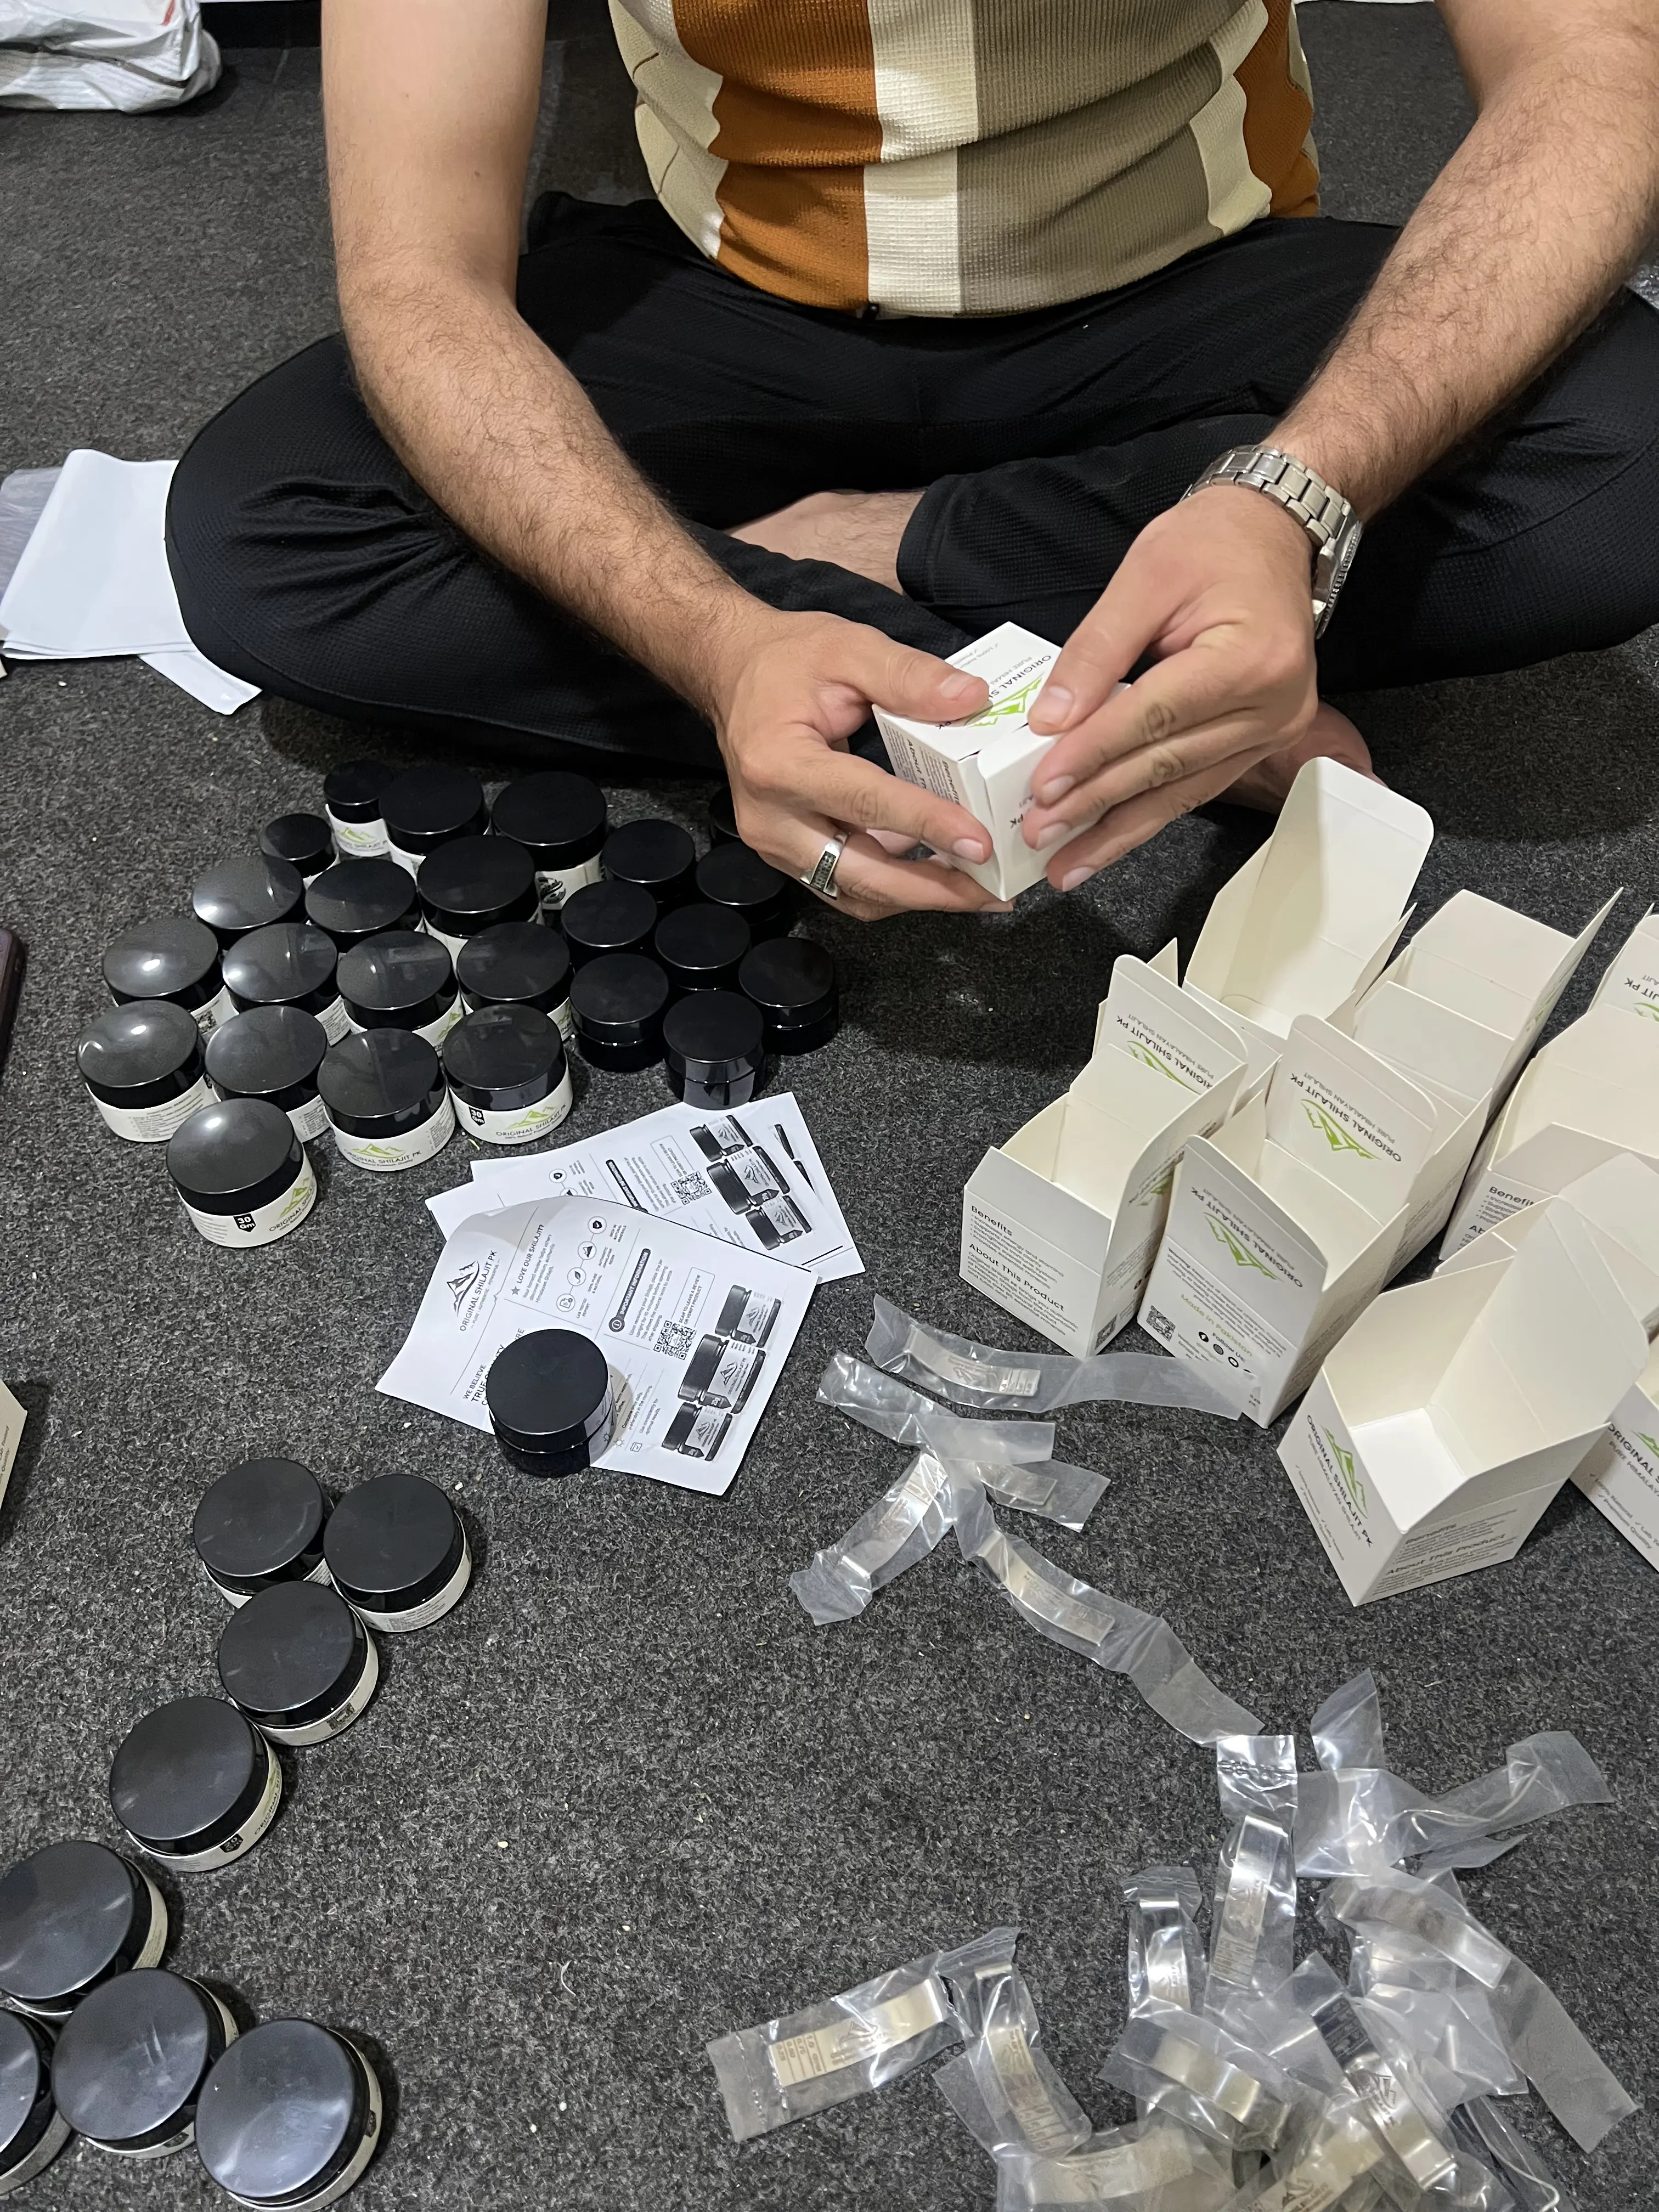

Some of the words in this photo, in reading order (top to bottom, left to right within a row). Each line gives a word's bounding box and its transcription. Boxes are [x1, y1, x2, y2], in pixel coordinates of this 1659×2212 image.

[998, 653, 1051, 689] ORIGINAL
[1623, 977, 1640, 991] PK
[1114, 1015, 1130, 1029] PK
[1129, 1026, 1172, 1060] SHILAJIT
[1171, 1057, 1214, 1090] RIGINAL
[1288, 1073, 1305, 1087] PK
[1302, 1071, 1334, 1096] SHILAJIT
[471, 1109, 482, 1118] 30
[1304, 1085, 1352, 1123] SHILAJIT
[1331, 1093, 1376, 1128] HIMALAYAN
[495, 1127, 532, 1136] ORIGINAL
[535, 1109, 560, 1129] SHILAJIT
[1374, 1126, 1396, 1144] PURE
[1348, 1119, 1404, 1163] ORIGINAL
[378, 1154, 410, 1164] SHILAJIT
[1188, 1186, 1206, 1201] PK
[236, 1216, 251, 1224] 30
[268, 1207, 301, 1231] ORIGINAL
[971, 1204, 1013, 1237] Benefits
[1205, 1200, 1252, 1242] SHILAJIT
[527, 1223, 546, 1253] SHILAJIT?
[515, 1266, 528, 1284] LOVE
[522, 1252, 534, 1267] OUR
[1249, 1239, 1305, 1289] ORIGINAL
[459, 1294, 479, 1332] ORIGINAL
[473, 1261, 493, 1295] SHILAJIT
[487, 1249, 497, 1261] PK
[619, 1285, 635, 1315] IMPORTANT
[630, 1250, 649, 1286] INFORMATION
[969, 1242, 999, 1267] About
[1002, 1264, 1022, 1283] This
[1023, 1279, 1065, 1312] Product
[1180, 1293, 1205, 1317] Made
[1205, 1313, 1215, 1325] in
[1215, 1323, 1254, 1357] Pakistan
[1211, 1331, 1235, 1353] Follow
[462, 1388, 472, 1400] WE
[469, 1363, 486, 1390] BELIEVE
[471, 1380, 488, 1404] TRUE
[1606, 1423, 1653, 1477] ORIGINAL
[1305, 1415, 1337, 1474] ORIGINAL
[1332, 1472, 1363, 1528] SHILAJIT
[1361, 1528, 1373, 1548] PK
